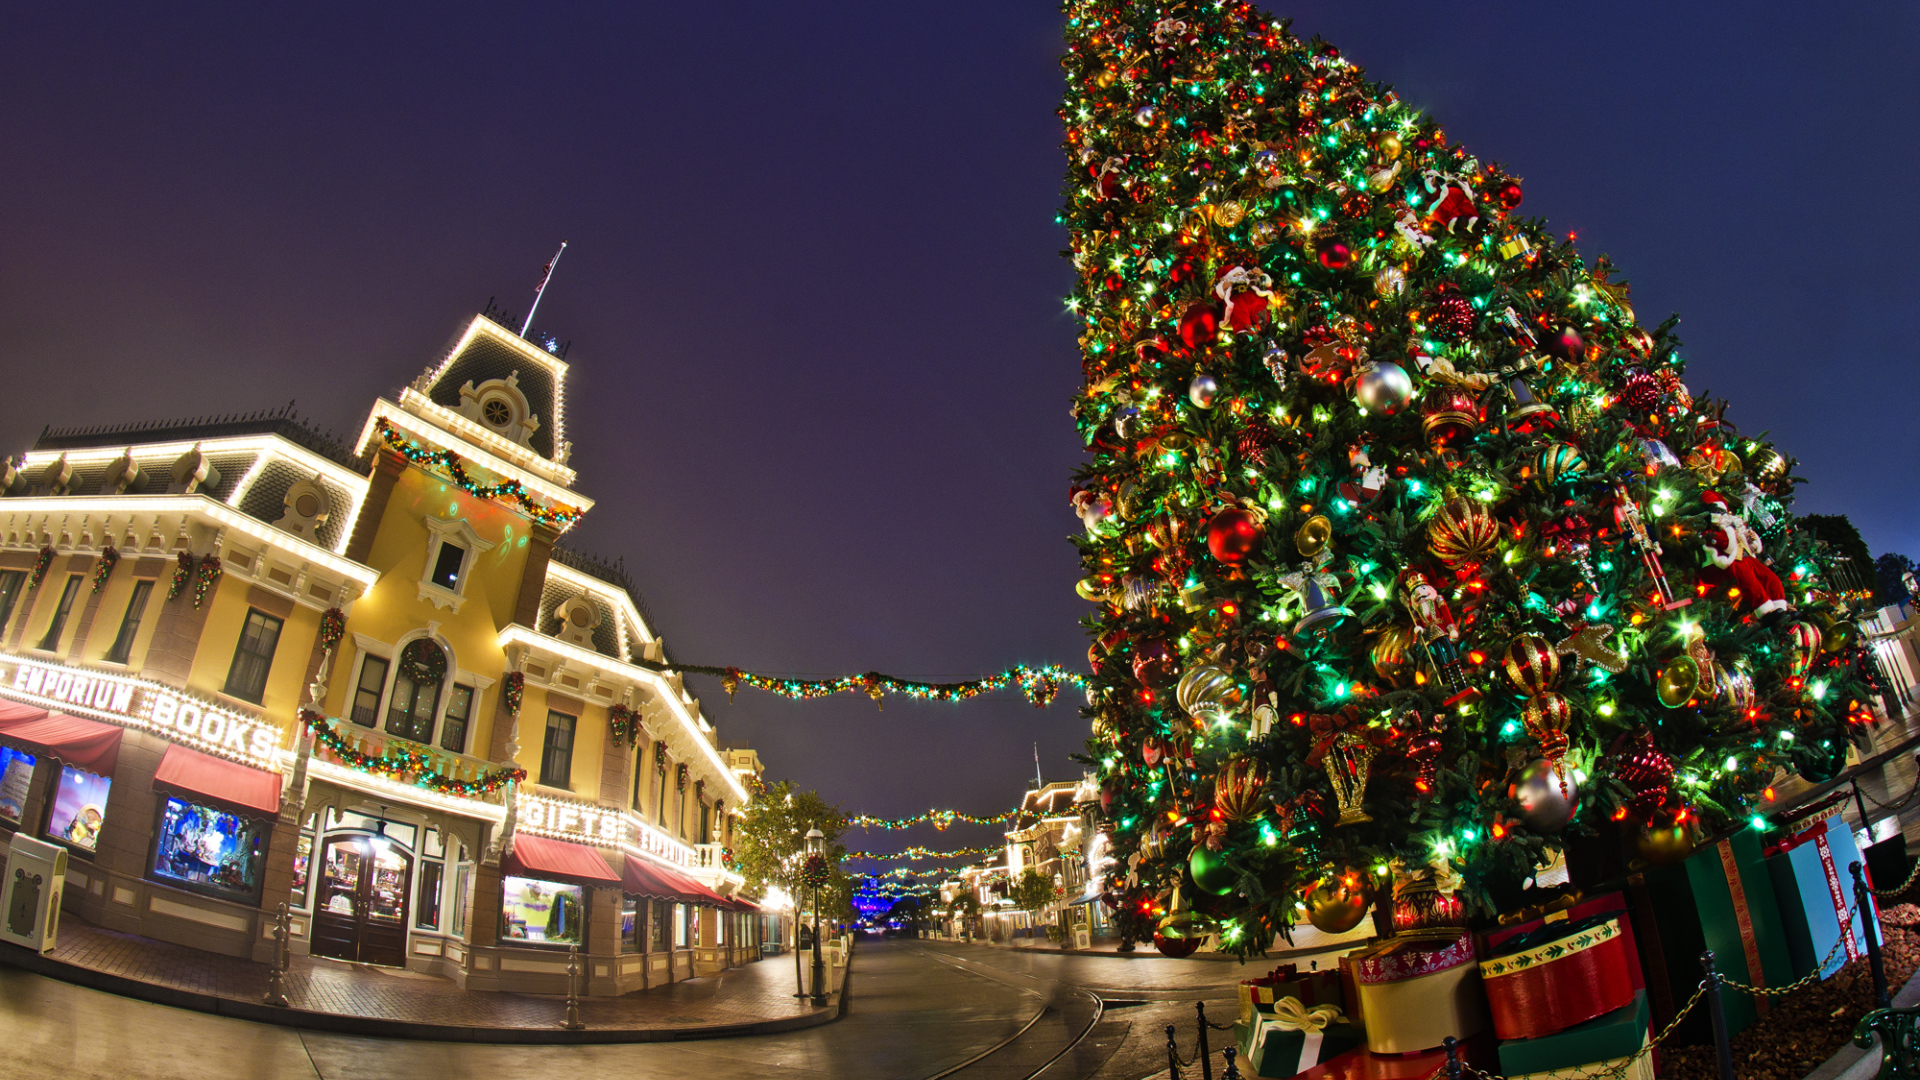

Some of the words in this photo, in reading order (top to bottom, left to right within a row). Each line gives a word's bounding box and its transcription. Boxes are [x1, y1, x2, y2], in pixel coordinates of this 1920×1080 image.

[13, 664, 136, 714] EMPORIUM
[151, 693, 276, 759] BOOKS
[524, 801, 619, 840] GIFTS
